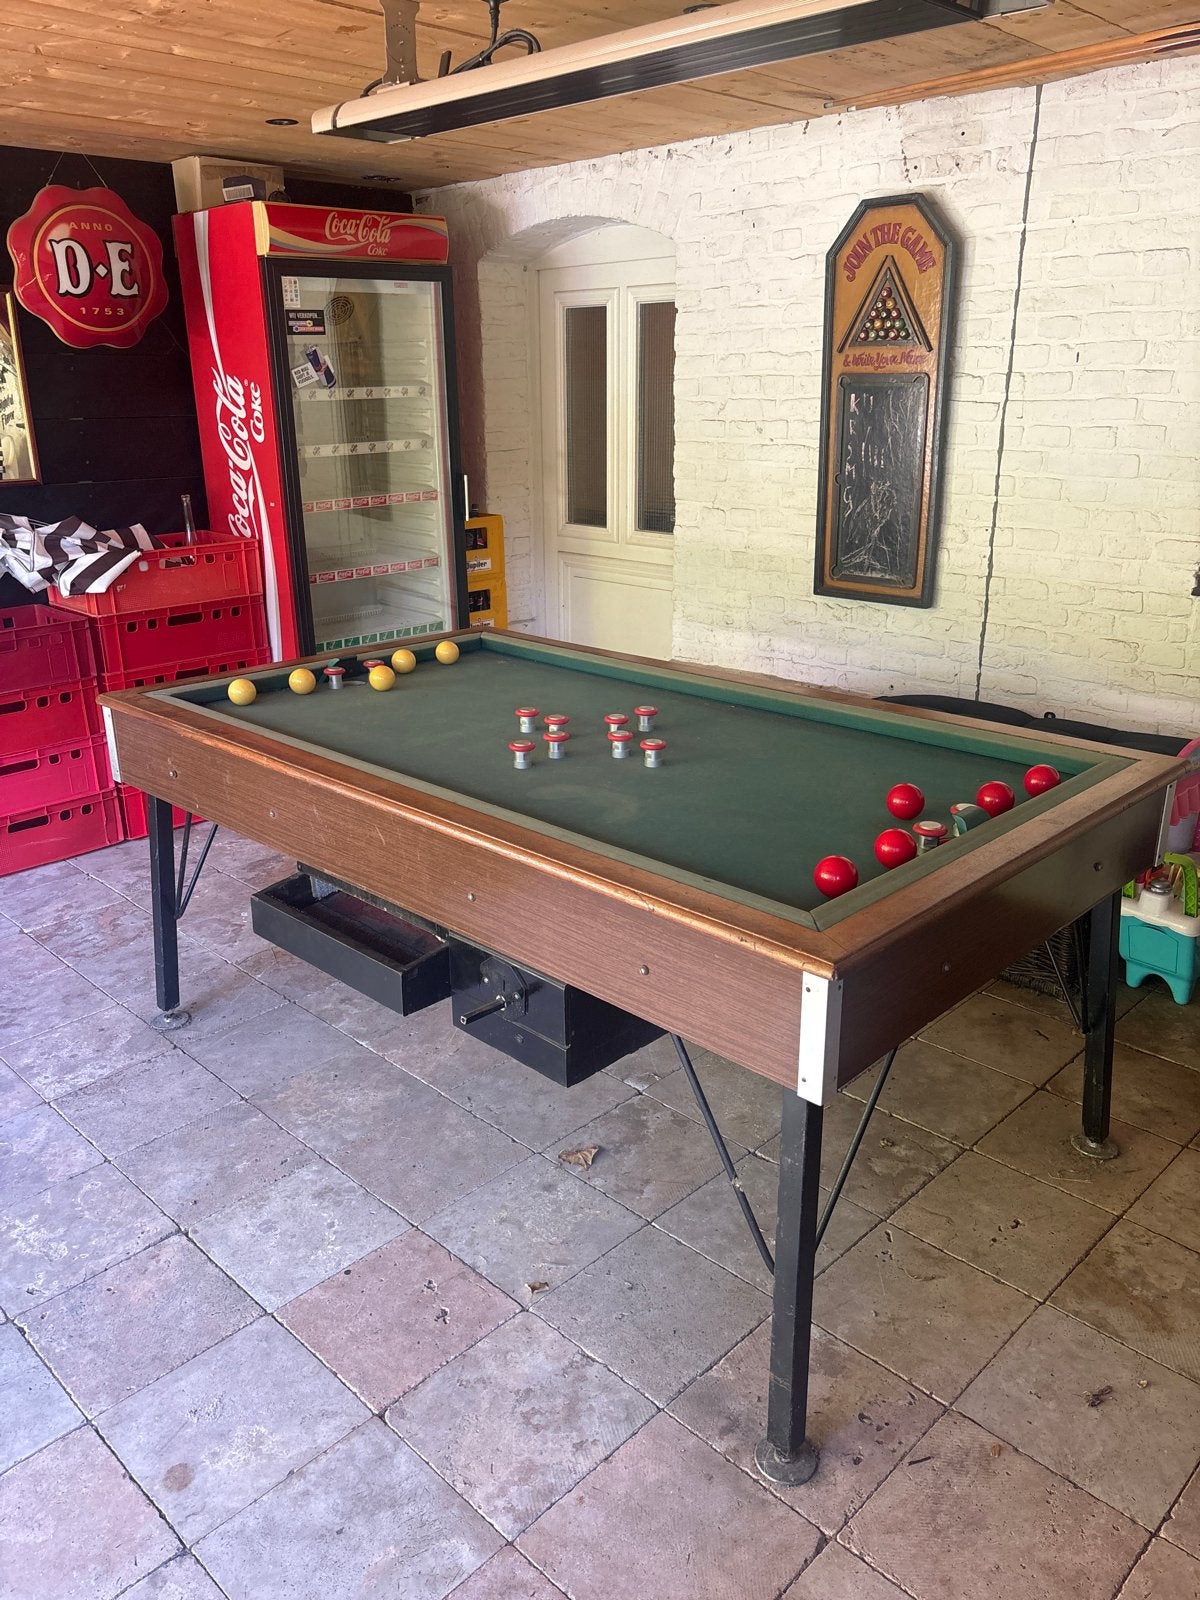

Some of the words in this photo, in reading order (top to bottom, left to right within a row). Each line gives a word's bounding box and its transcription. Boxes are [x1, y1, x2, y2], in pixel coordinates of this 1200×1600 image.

[69, 221, 113, 232] ANNO
[325, 211, 391, 243] Coca-Cola
[367, 243, 389, 256] Coke
[843, 232, 874, 283] JOIN
[870, 222, 903, 249] THE
[900, 225, 937, 275] GAME
[79, 307, 125, 316] 1753
[250, 381, 265, 443] Coke
